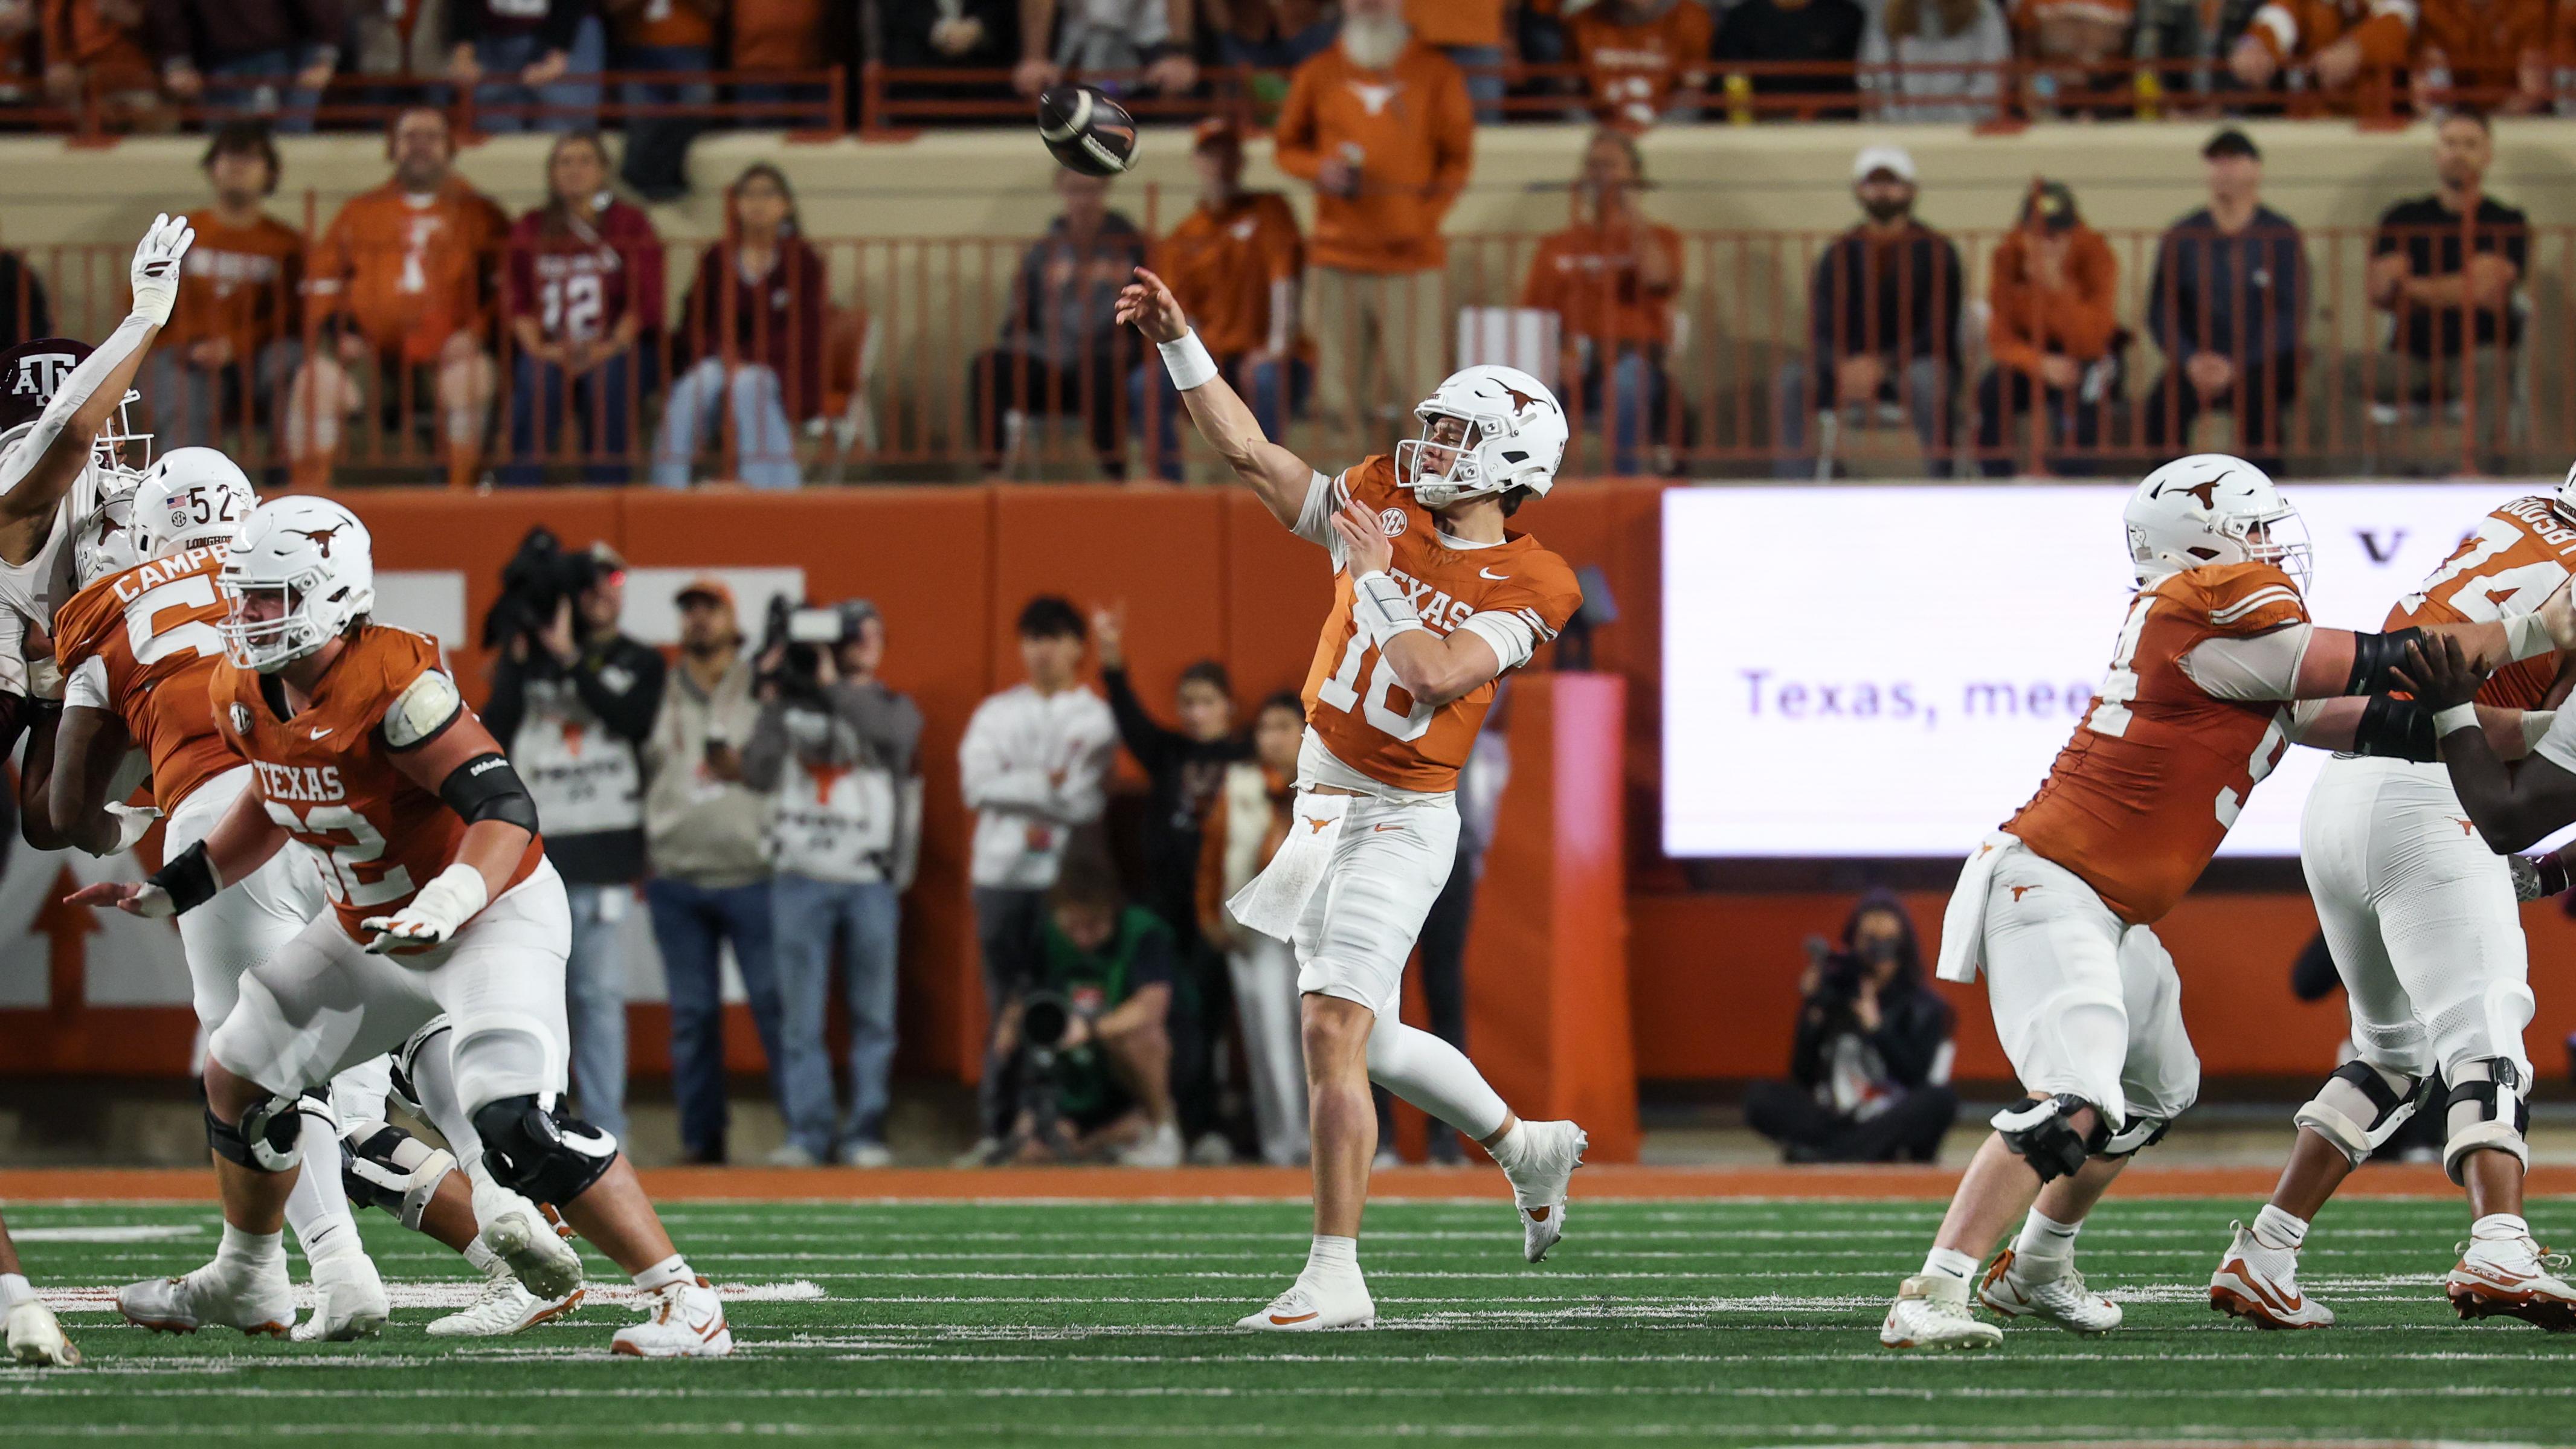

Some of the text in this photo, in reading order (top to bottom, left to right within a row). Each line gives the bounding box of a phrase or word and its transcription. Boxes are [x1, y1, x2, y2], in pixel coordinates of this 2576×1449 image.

[541, 275, 604, 342] 12
[189, 484, 234, 524] 52
[1380, 508, 1407, 536] SEC
[1740, 668, 1937, 731] Texas,
[253, 758, 346, 802] TEXAS
